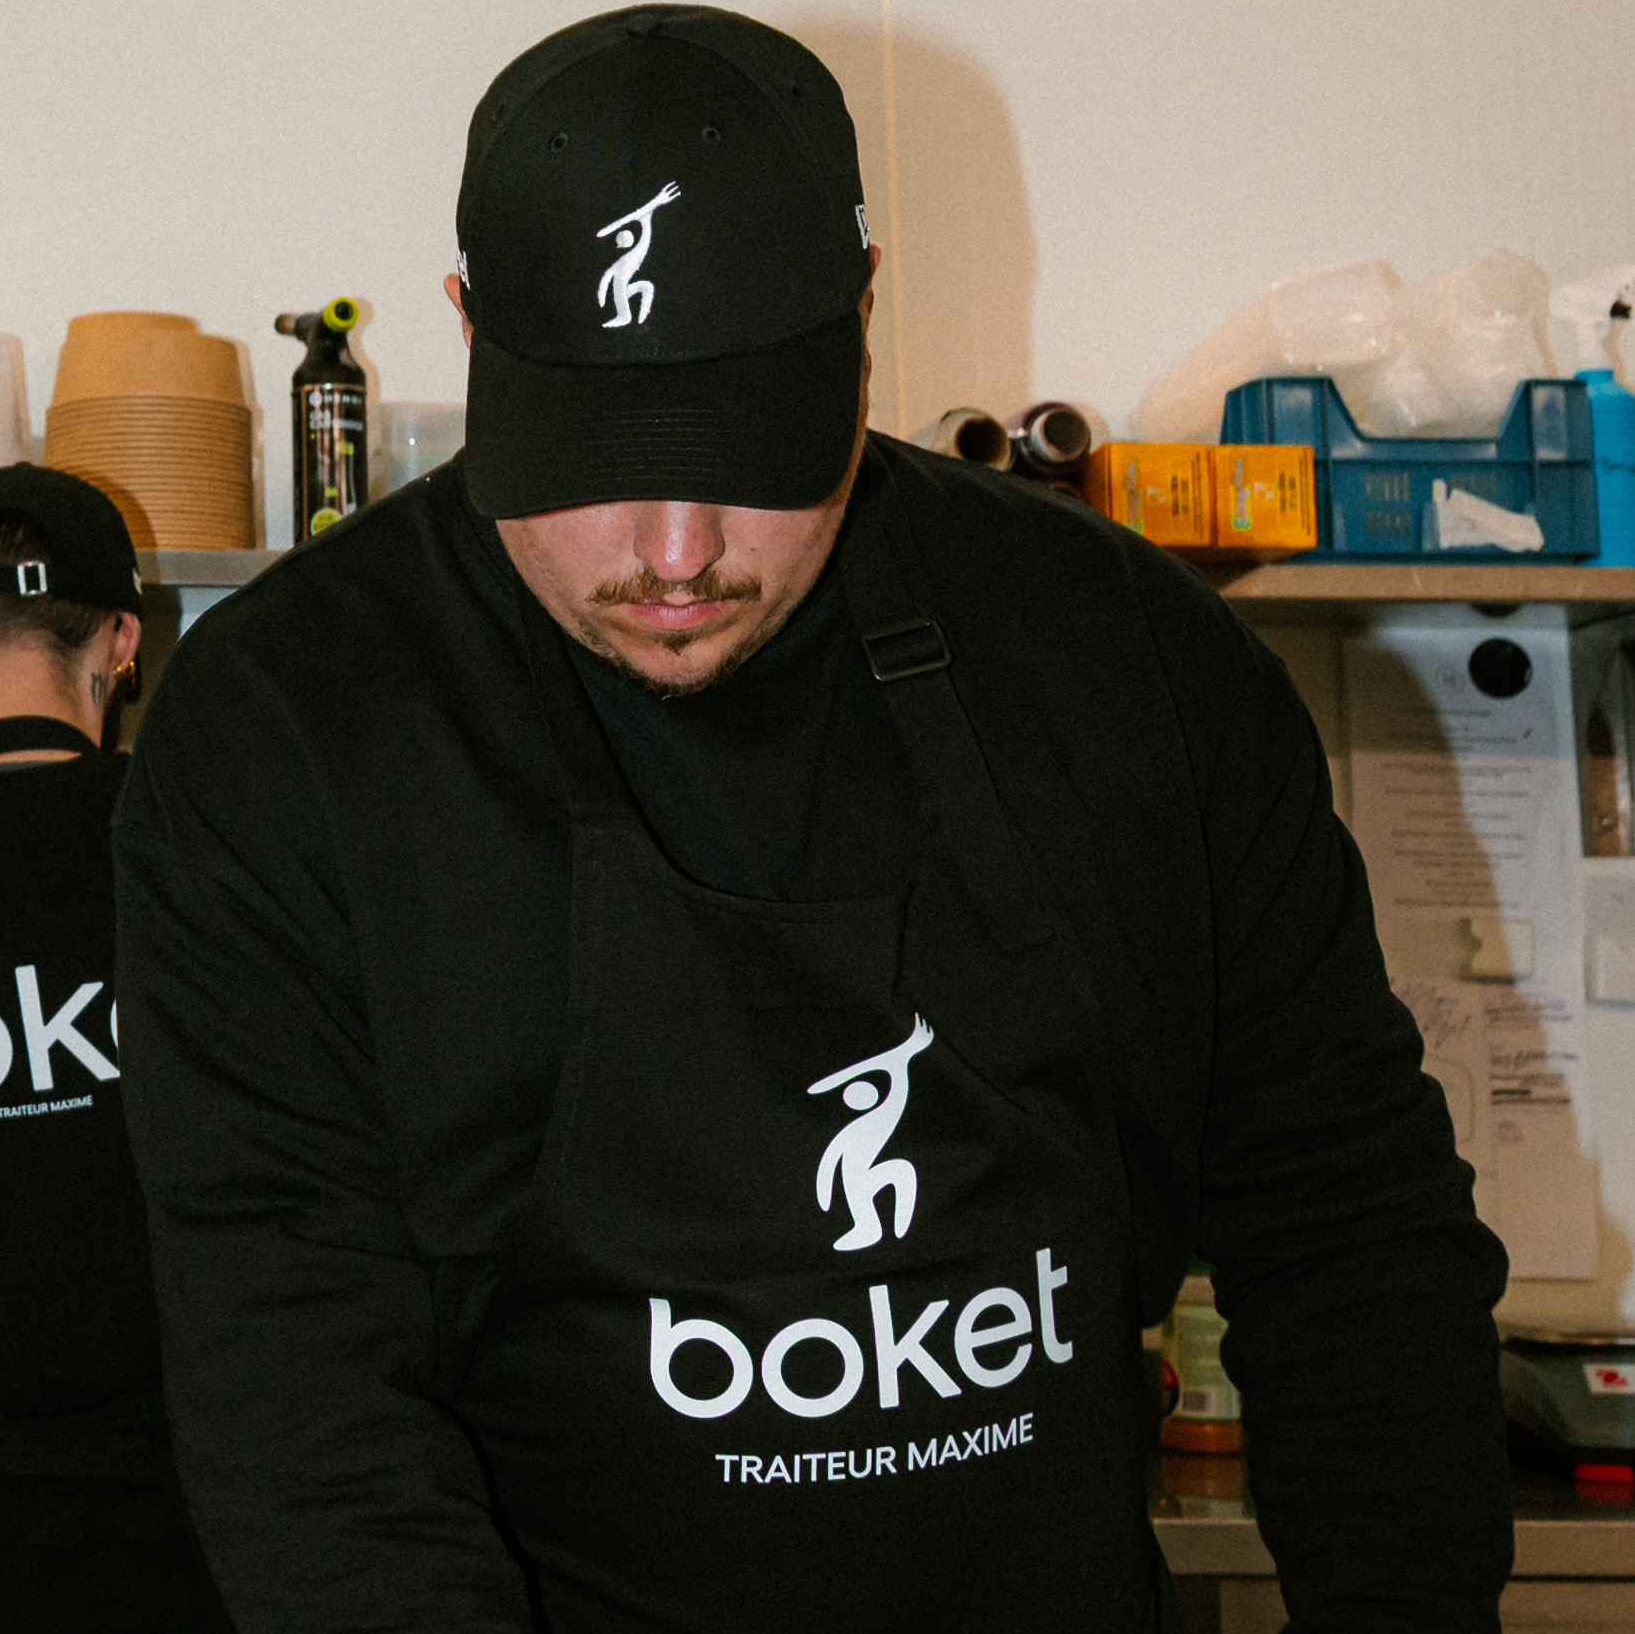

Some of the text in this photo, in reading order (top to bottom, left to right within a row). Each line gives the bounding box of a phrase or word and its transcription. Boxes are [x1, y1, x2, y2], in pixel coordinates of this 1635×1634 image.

[50, 1095, 93, 1112] MAXIME
[649, 1247, 1073, 1418] boket
[715, 1412, 1034, 1484] TRAITEUR MAXIME
